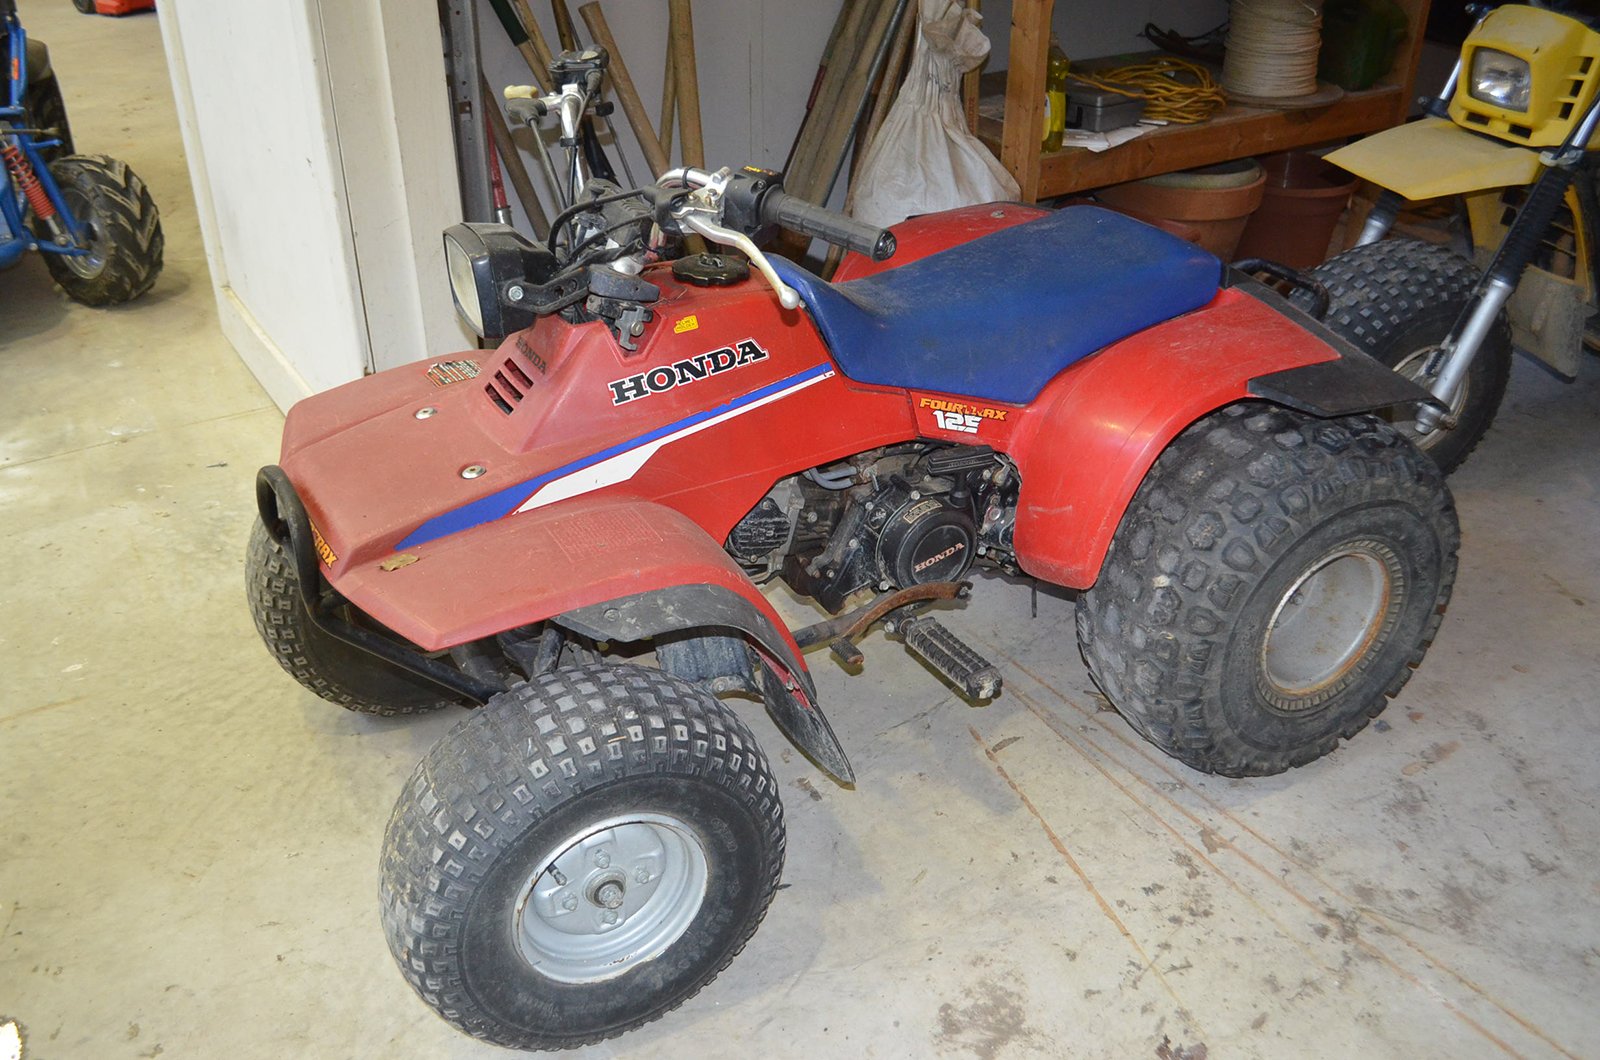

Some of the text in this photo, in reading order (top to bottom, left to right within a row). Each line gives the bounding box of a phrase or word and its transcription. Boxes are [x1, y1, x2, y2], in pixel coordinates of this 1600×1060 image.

[515, 335, 546, 375] HONDA
[609, 338, 768, 405] HONDA
[914, 542, 965, 573] HONDA
